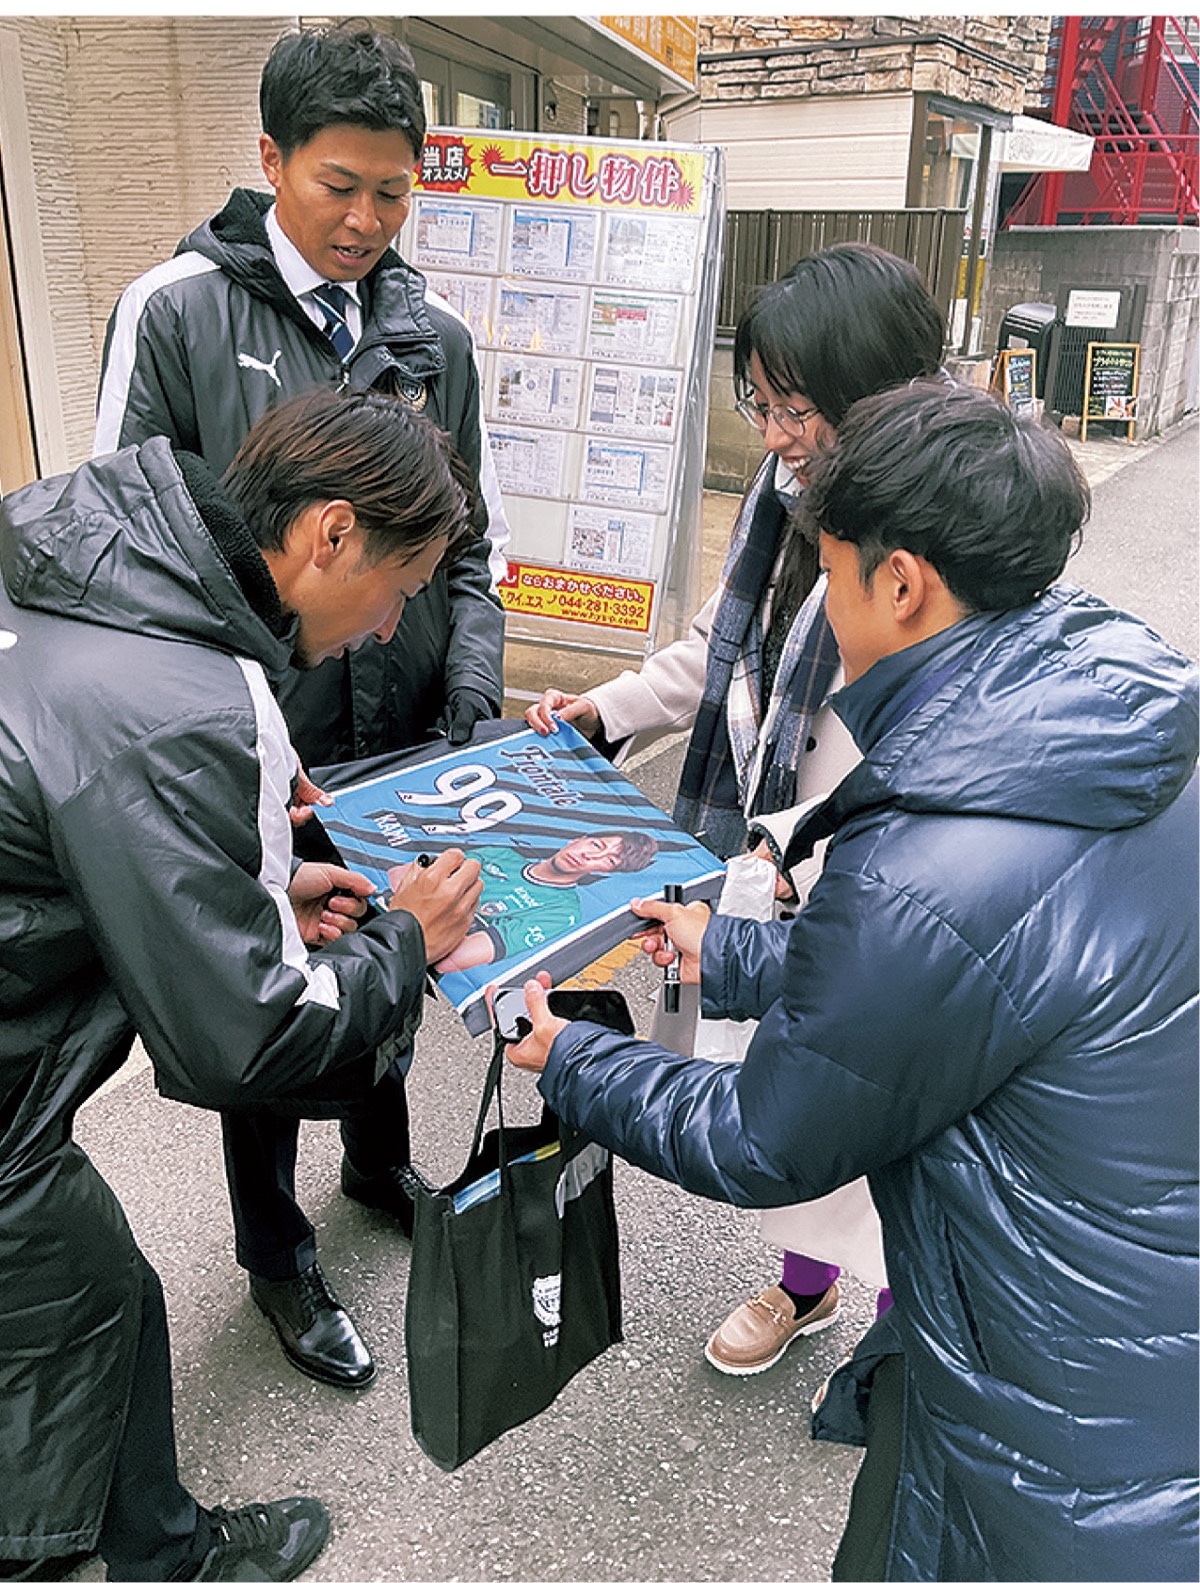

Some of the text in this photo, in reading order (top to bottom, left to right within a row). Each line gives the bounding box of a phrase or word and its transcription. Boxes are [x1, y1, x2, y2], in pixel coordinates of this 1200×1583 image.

[423, 146, 464, 167] 当店
[490, 151, 680, 203] 一押し物件
[395, 763, 524, 836] 99
[499, 744, 583, 807] Frontale
[373, 813, 412, 847] KAMI
